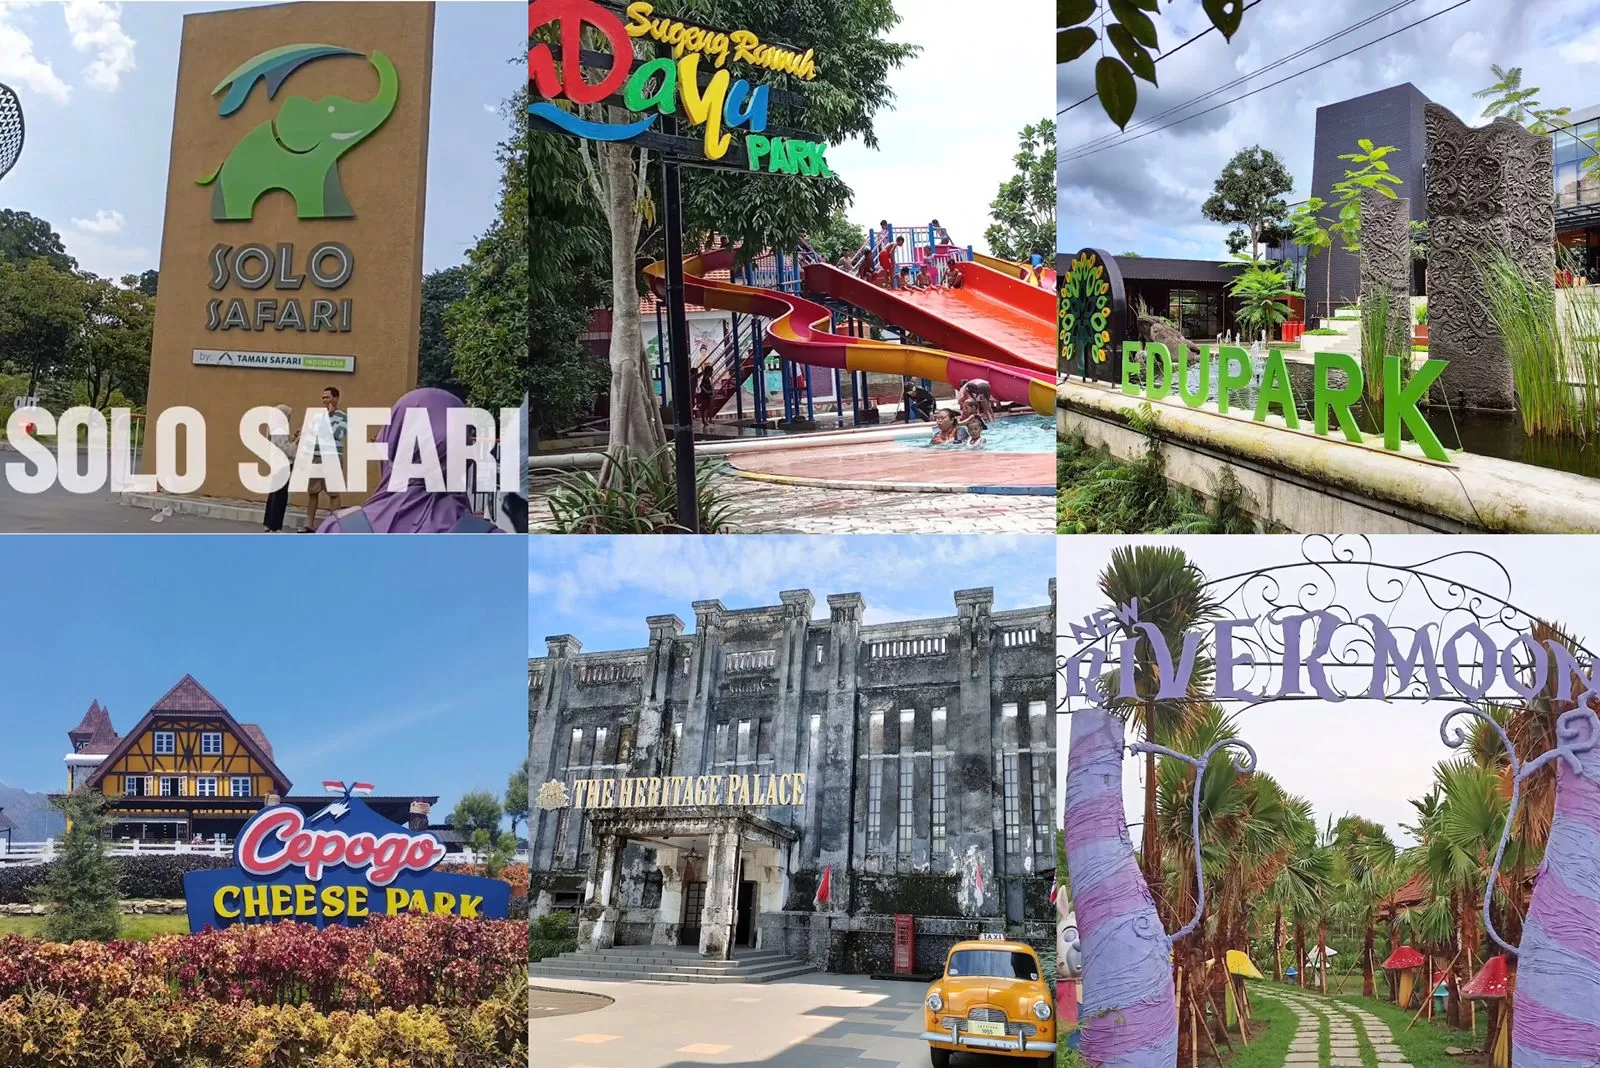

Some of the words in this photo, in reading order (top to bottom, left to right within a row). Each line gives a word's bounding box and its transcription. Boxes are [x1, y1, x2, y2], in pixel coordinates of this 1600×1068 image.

[627, 1, 730, 68] Sugeng
[745, 134, 832, 178] PARK
[207, 241, 354, 291] SOLO
[205, 298, 353, 332] SAFARI
[236, 354, 268, 364] TAMAN
[269, 356, 302, 366] SAFARI
[303, 357, 345, 368] INDONESIA
[1121, 341, 1452, 463] EDUPARK
[1068, 597, 1139, 645] NEW
[572, 779, 615, 809] THE
[618, 774, 722, 809] HERITAGE
[726, 772, 806, 806] PALACE
[237, 806, 446, 886] Cepogo
[213, 884, 368, 918] CHEESE
[385, 887, 484, 918] PARK
